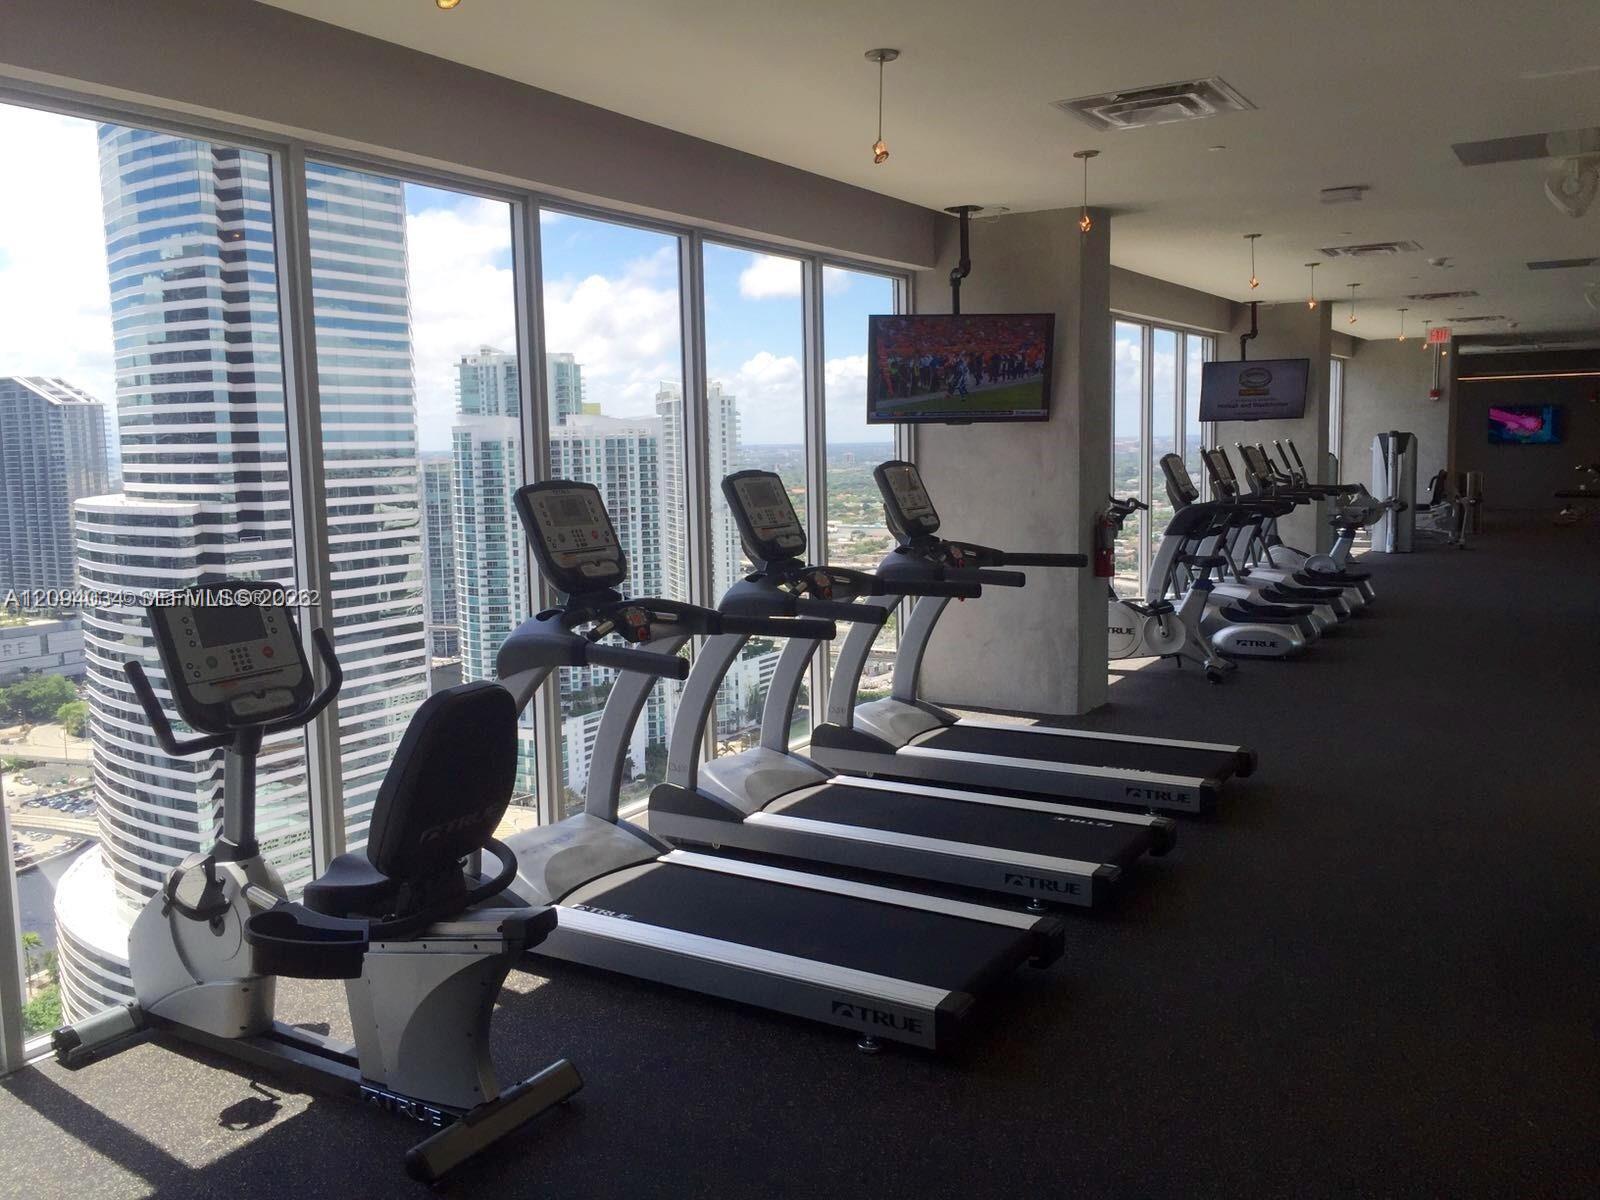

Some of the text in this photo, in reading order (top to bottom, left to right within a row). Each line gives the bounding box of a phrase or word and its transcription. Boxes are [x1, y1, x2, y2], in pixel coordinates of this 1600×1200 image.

[1249, 640, 1280, 648] TRUE
[1145, 789, 1192, 804] TRUE
[1024, 875, 1081, 896] TRUE
[859, 1005, 923, 1034] TRUE
